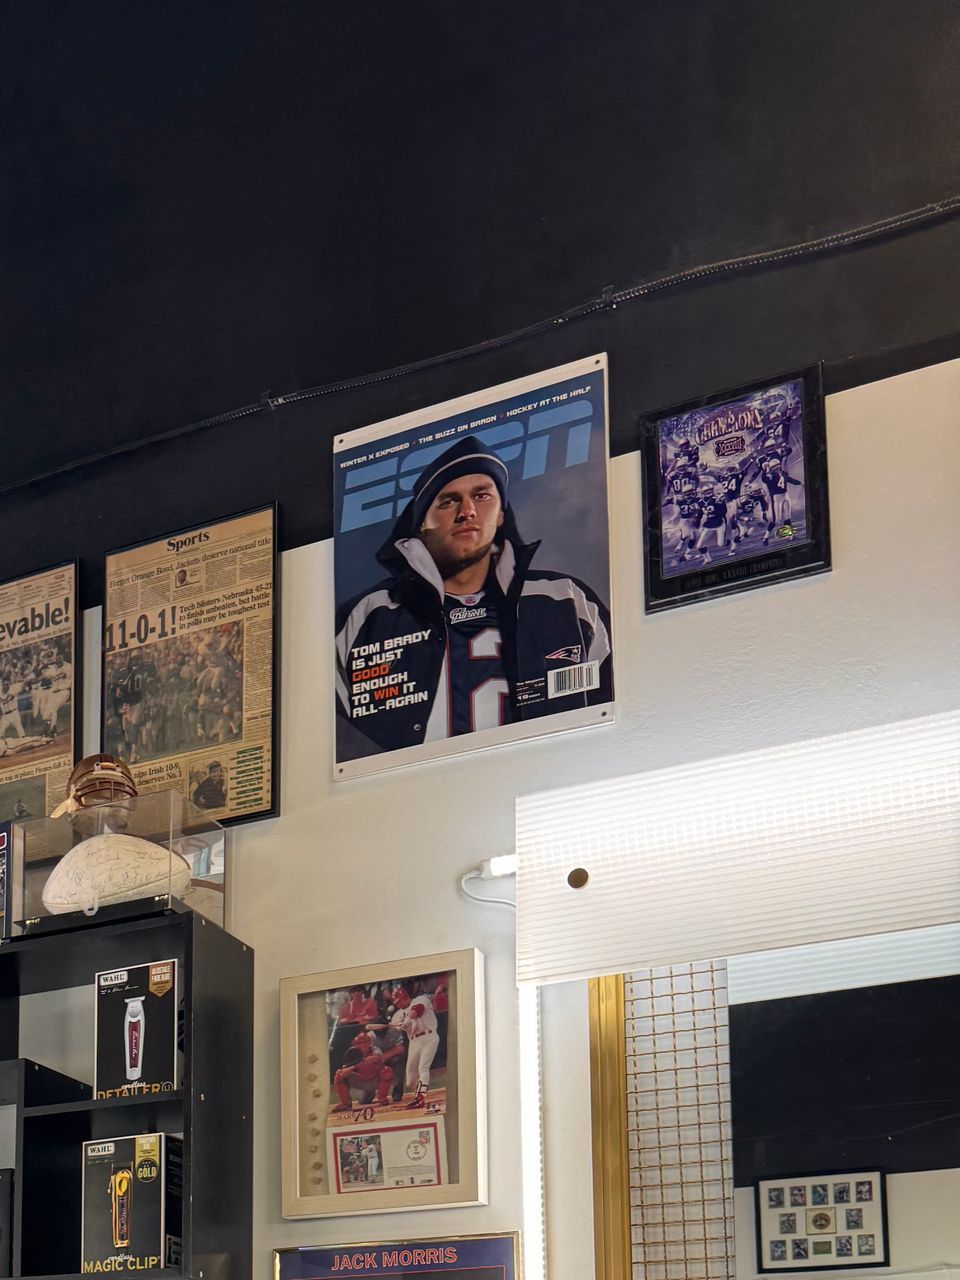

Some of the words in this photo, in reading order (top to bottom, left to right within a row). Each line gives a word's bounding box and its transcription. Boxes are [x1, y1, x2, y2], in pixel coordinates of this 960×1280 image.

[506, 402, 538, 417] HOCKEY
[540, 398, 550, 407] AT
[551, 393, 568, 402] THE
[569, 386, 592, 397] HALF
[418, 435, 433, 444] THE
[435, 428, 456, 439] BUZZ
[457, 424, 468, 432] ON
[340, 456, 367, 469] WINTER
[375, 443, 410, 458] EXPOSED
[166, 531, 210, 552] Sports
[131, 570, 156, 583] Orange
[201, 549, 228, 562] deserve
[229, 541, 257, 555] national
[257, 536, 272, 547] title
[179, 604, 196, 614] Tech
[222, 588, 254, 602] Nebraska
[179, 614, 186, 622] to
[250, 592, 271, 604] battle
[179, 622, 186, 630] in
[203, 615, 218, 626] may
[218, 610, 227, 619] be
[227, 603, 256, 617] toughest
[257, 599, 270, 609] test
[104, 606, 177, 651] 11-0-1!
[351, 642, 380, 658] TOM
[384, 629, 432, 650] BRADY
[352, 658, 366, 670] IS
[368, 649, 404, 666] JUST
[352, 663, 390, 682] GOOD
[352, 671, 408, 694] ENOUGH
[352, 693, 370, 706] TO
[373, 686, 399, 700] WIN
[403, 681, 417, 694] IT
[352, 691, 429, 718] ALL-AGAIN
[148, 764, 165, 775] Irish
[102, 973, 126, 984] WAHL
[352, 1107, 374, 1122] 70
[89, 1144, 113, 1154] WAHL
[137, 1166, 157, 1178] GOLD
[84, 1259, 124, 1274] MAGIC
[127, 1256, 158, 1270] CLIP
[331, 1252, 378, 1271] JACK
[382, 1247, 458, 1267] MORRIS
